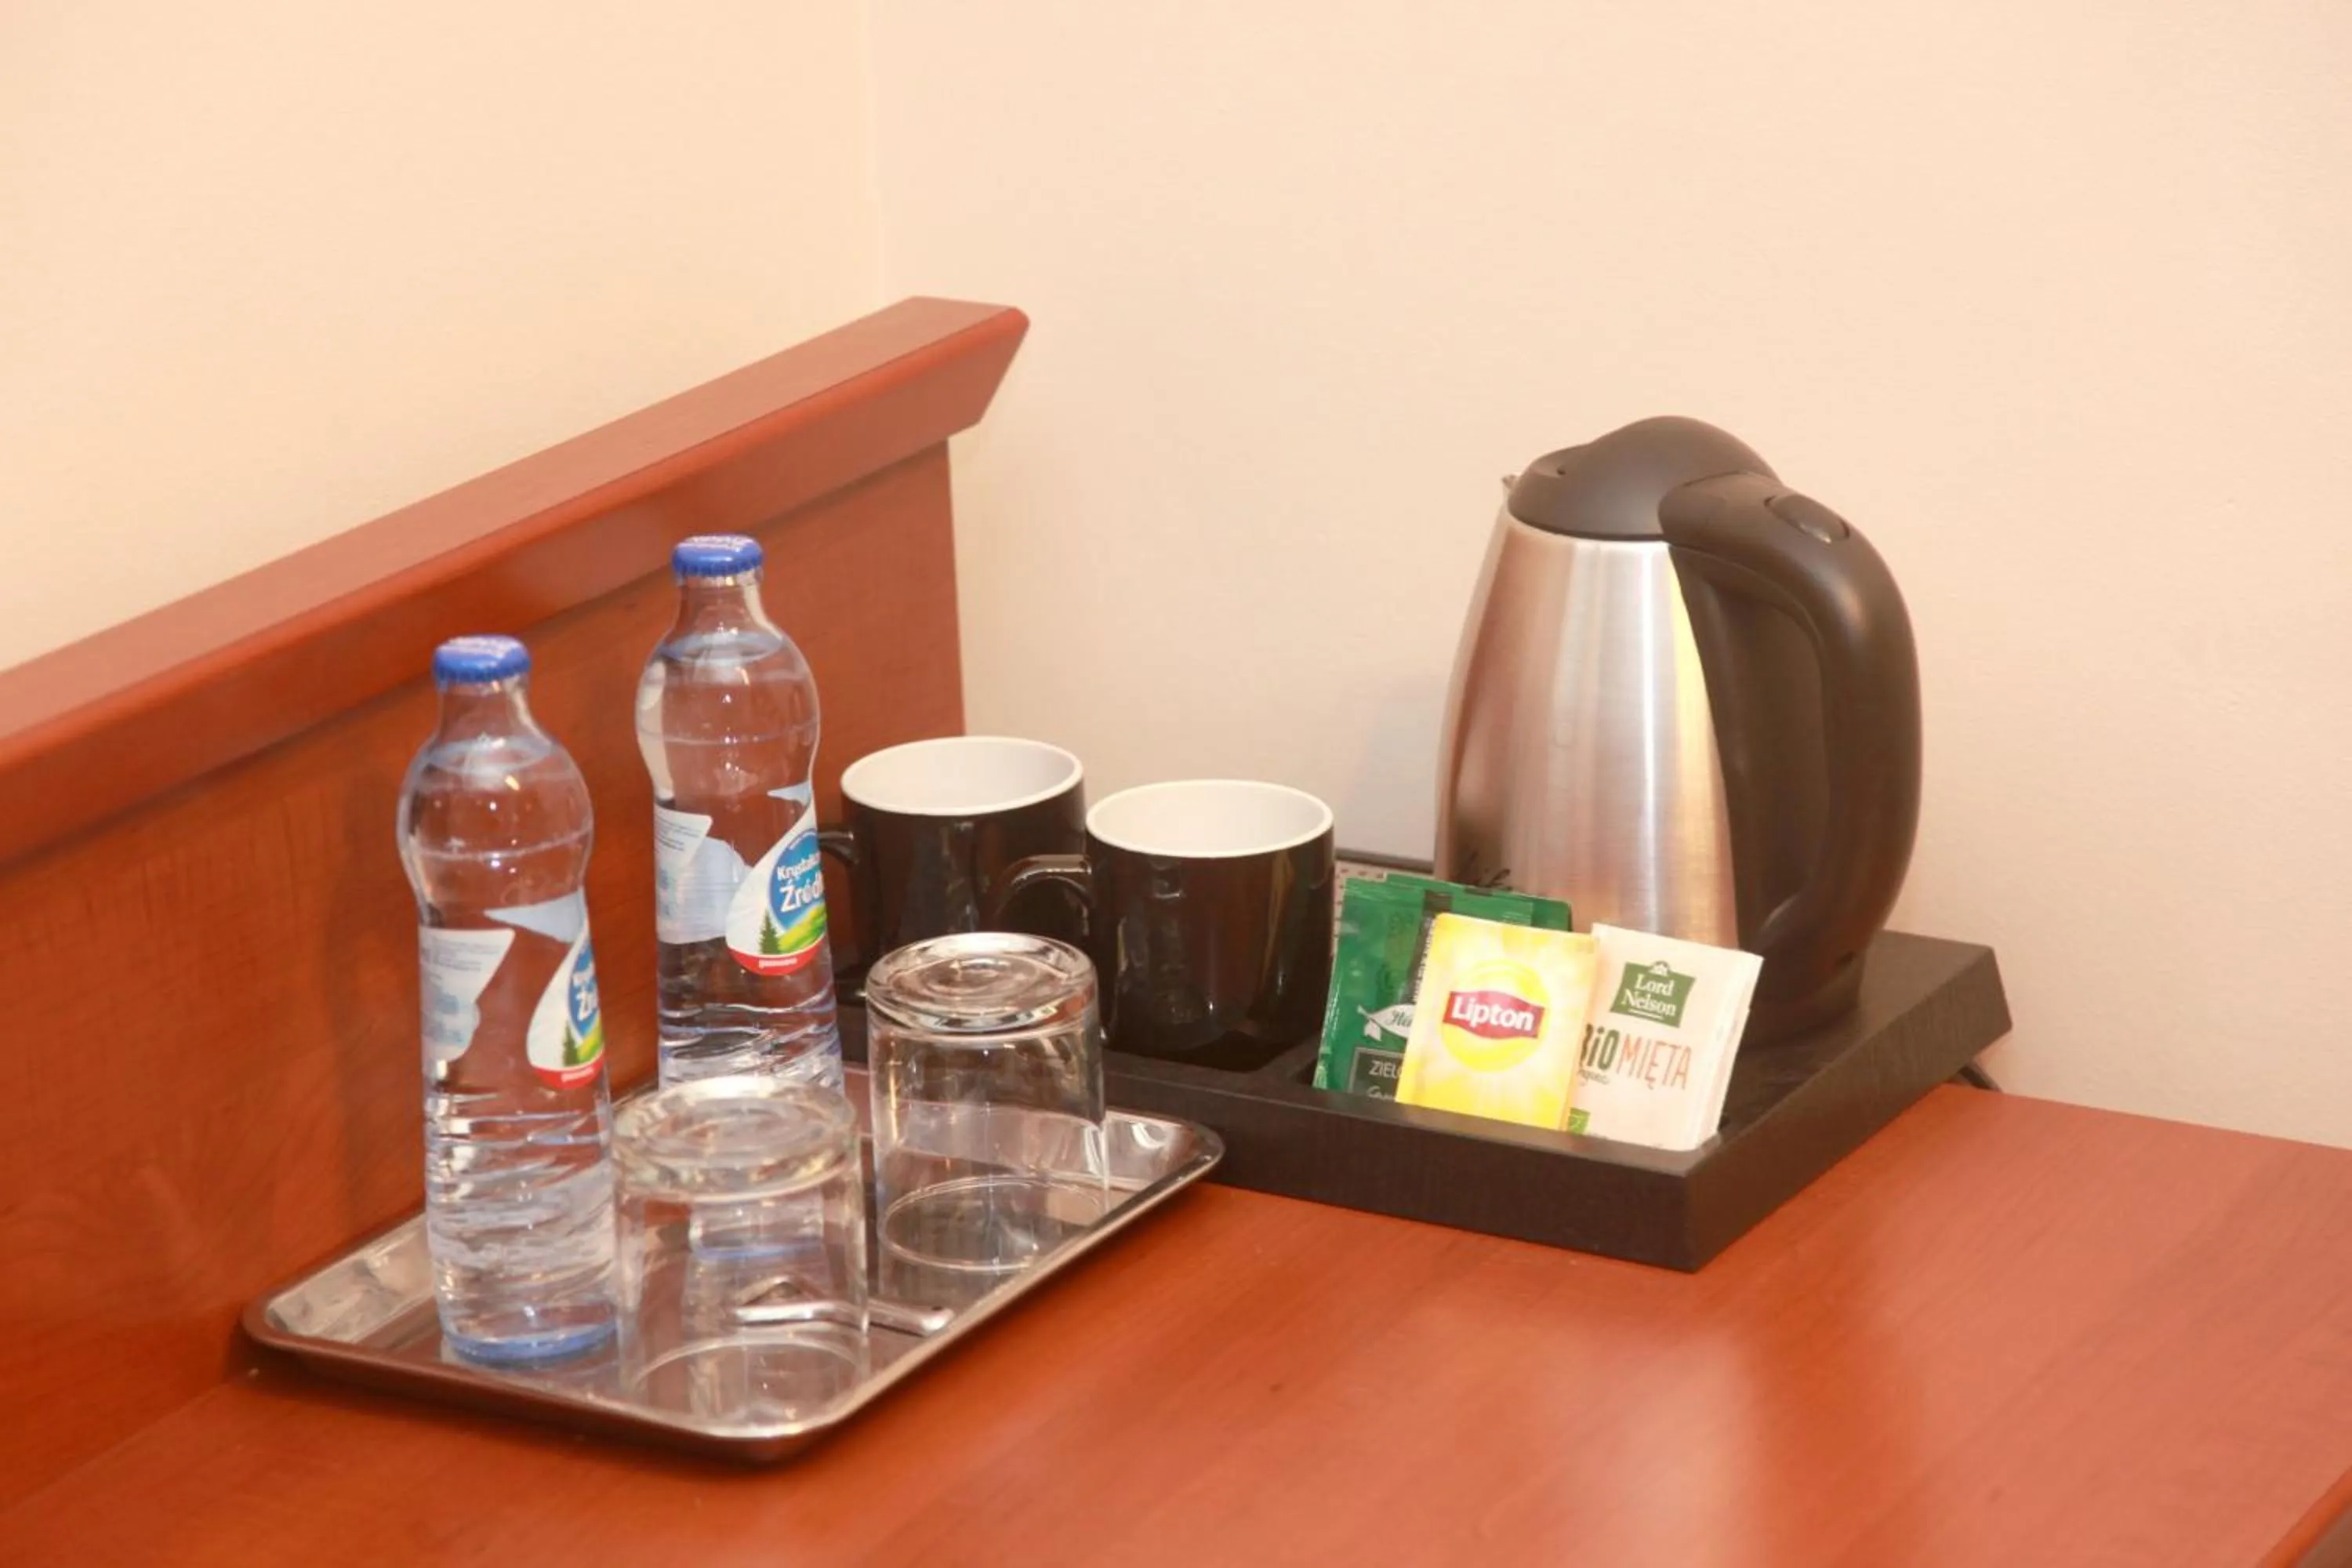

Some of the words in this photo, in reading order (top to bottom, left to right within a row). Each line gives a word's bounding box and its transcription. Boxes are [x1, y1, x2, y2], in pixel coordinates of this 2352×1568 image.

[1635, 973, 1675, 996] Lord
[1451, 996, 1535, 1031] Lipton
[1621, 989, 1676, 1017] Nelson
[1616, 1033, 1692, 1091] MIĘTA
